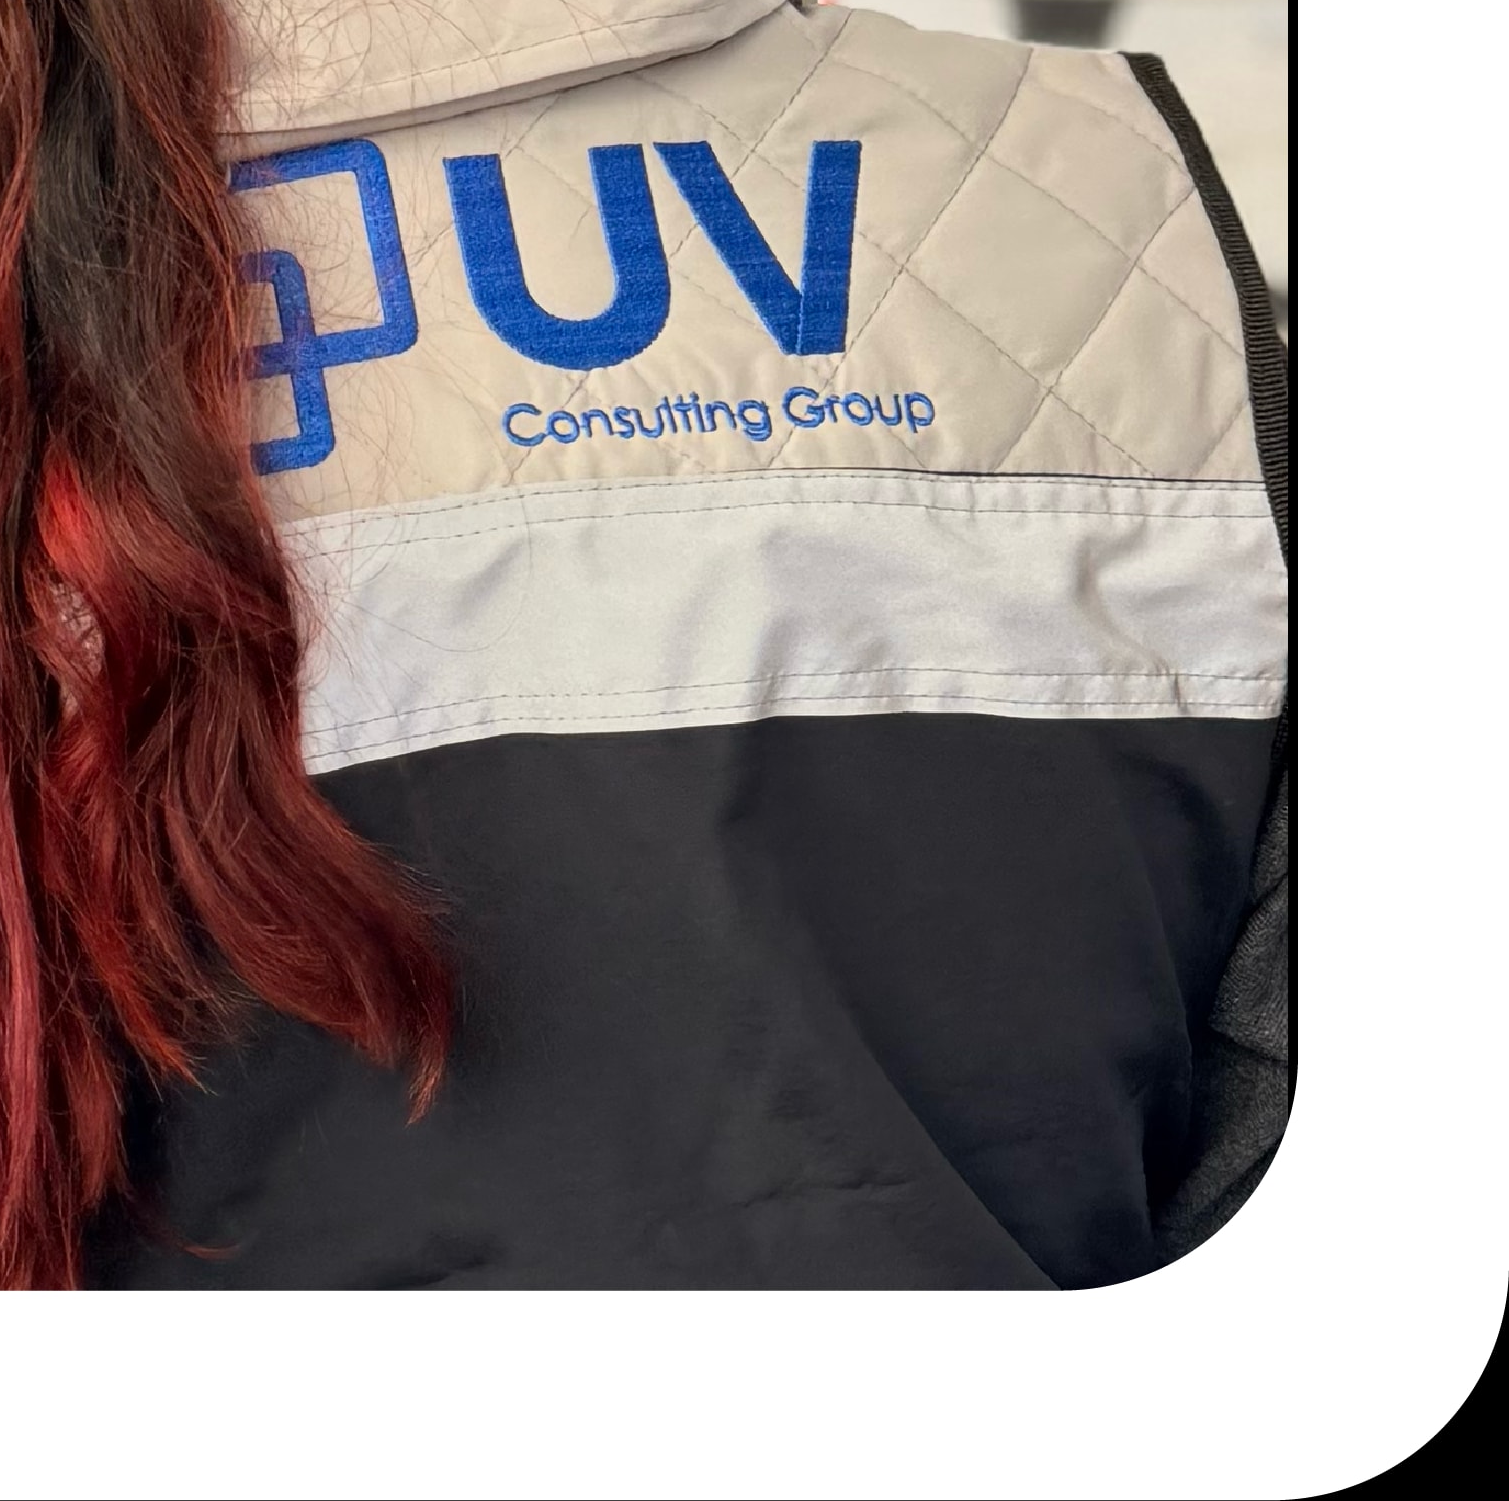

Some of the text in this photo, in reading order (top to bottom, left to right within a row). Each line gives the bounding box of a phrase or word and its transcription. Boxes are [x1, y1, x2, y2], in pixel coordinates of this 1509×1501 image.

[442, 140, 861, 371] UV
[502, 386, 936, 447] Consulting Group
